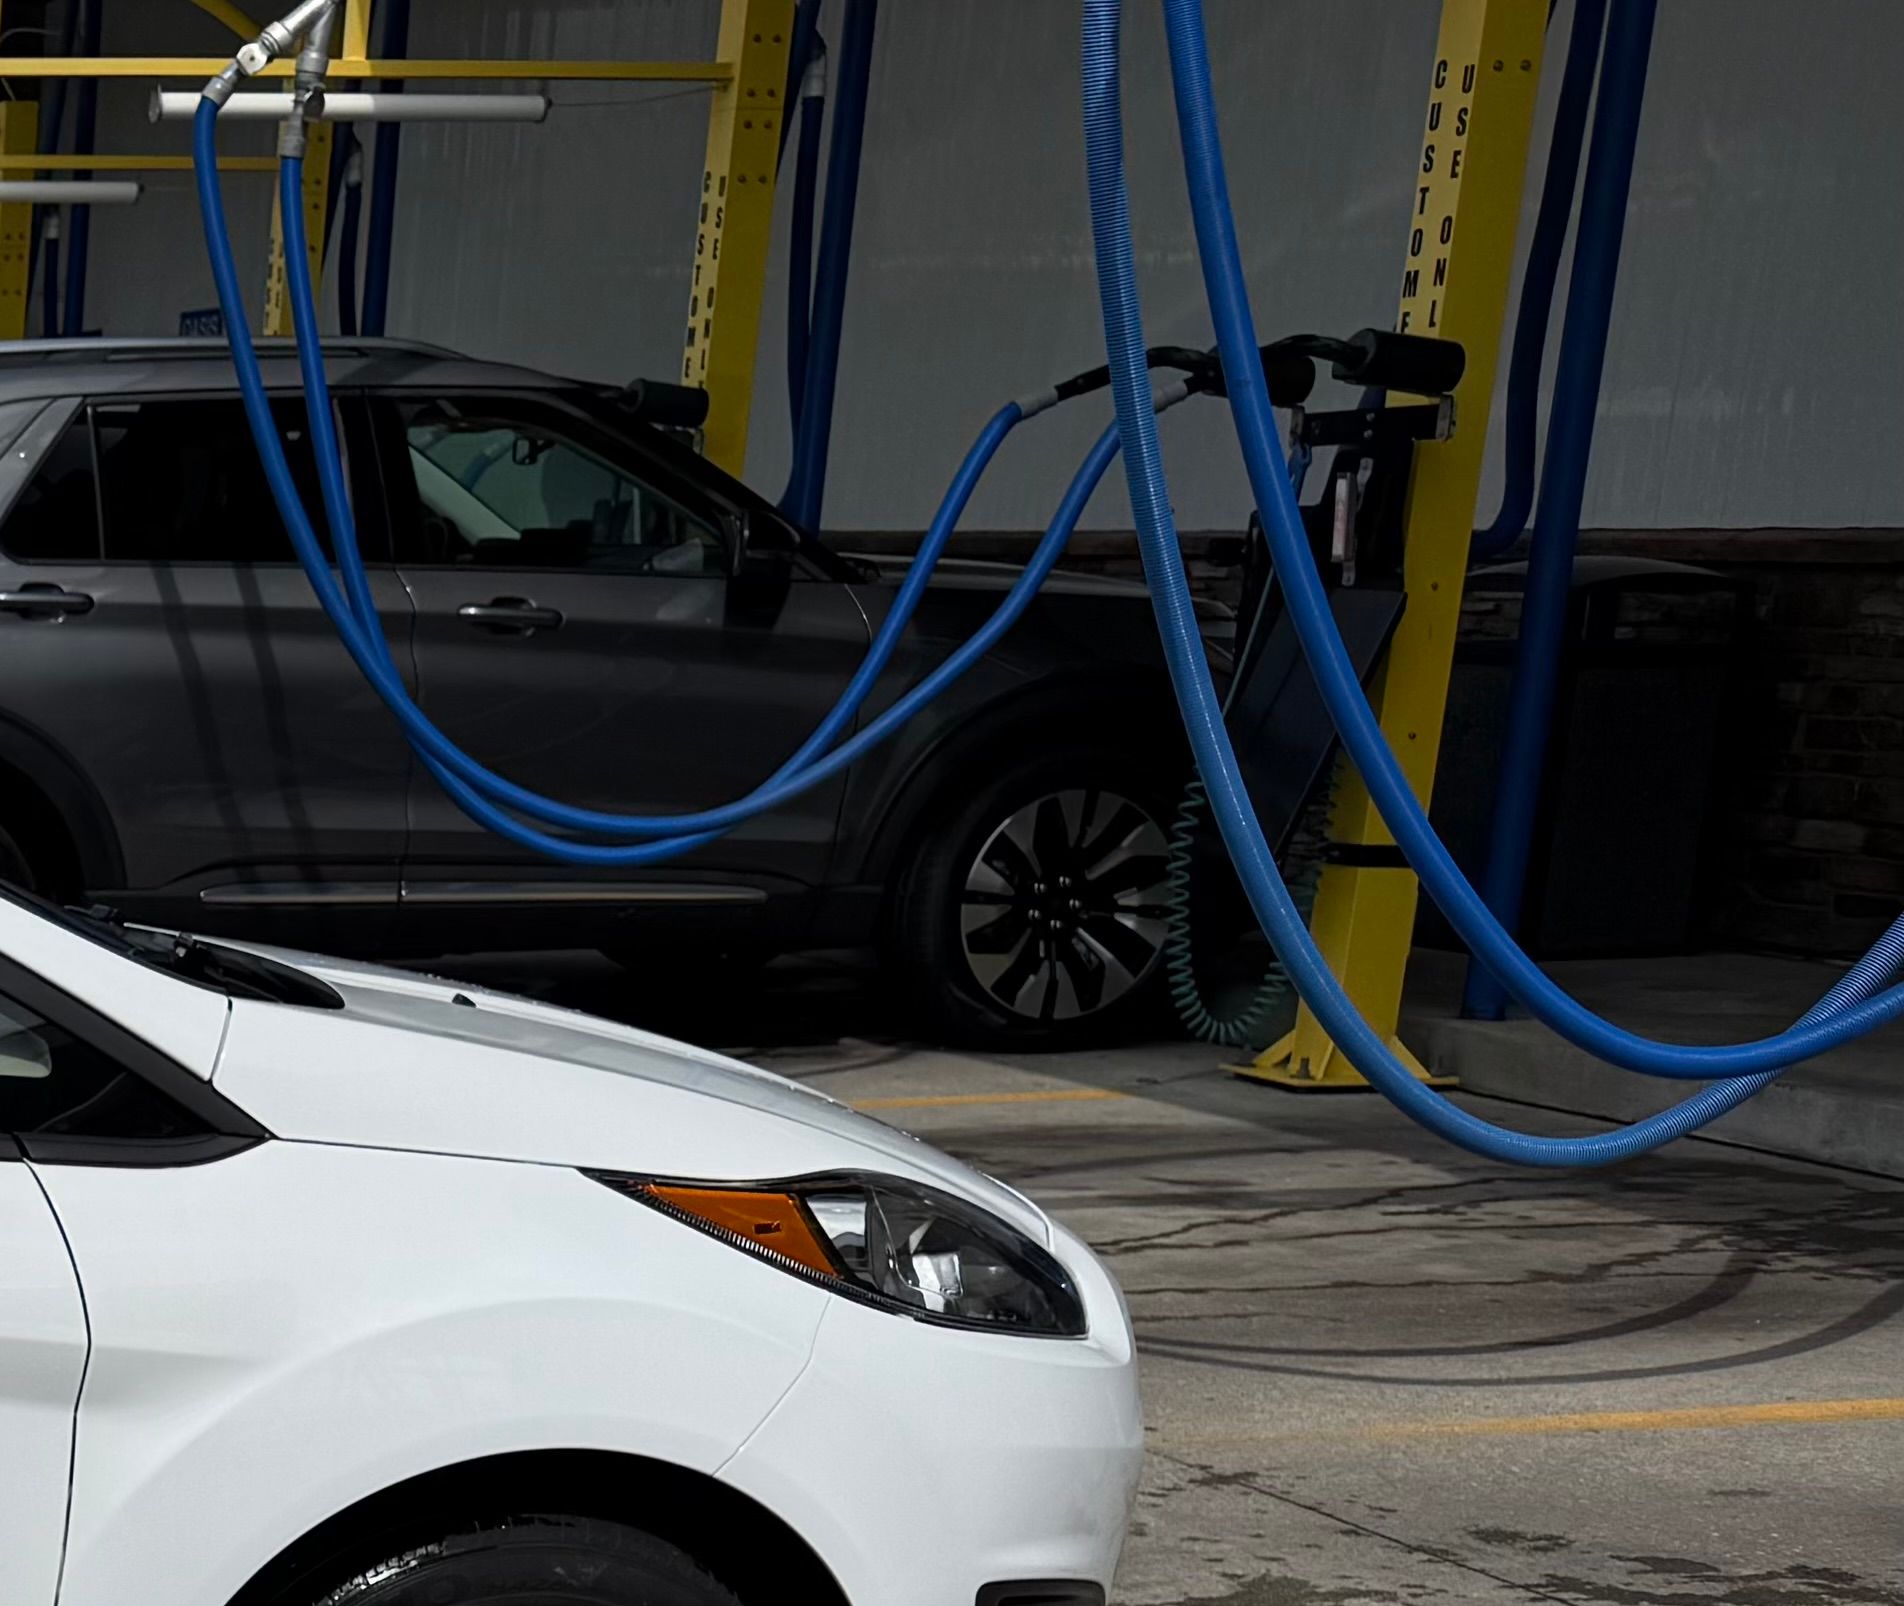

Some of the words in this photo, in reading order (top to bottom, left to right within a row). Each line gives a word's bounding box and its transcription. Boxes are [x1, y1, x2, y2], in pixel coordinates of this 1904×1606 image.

[1400, 59, 1448, 335] CUSTOME
[1450, 63, 1476, 179] USE
[684, 170, 712, 378] CUSTOME
[1428, 215, 1453, 329] ONL
